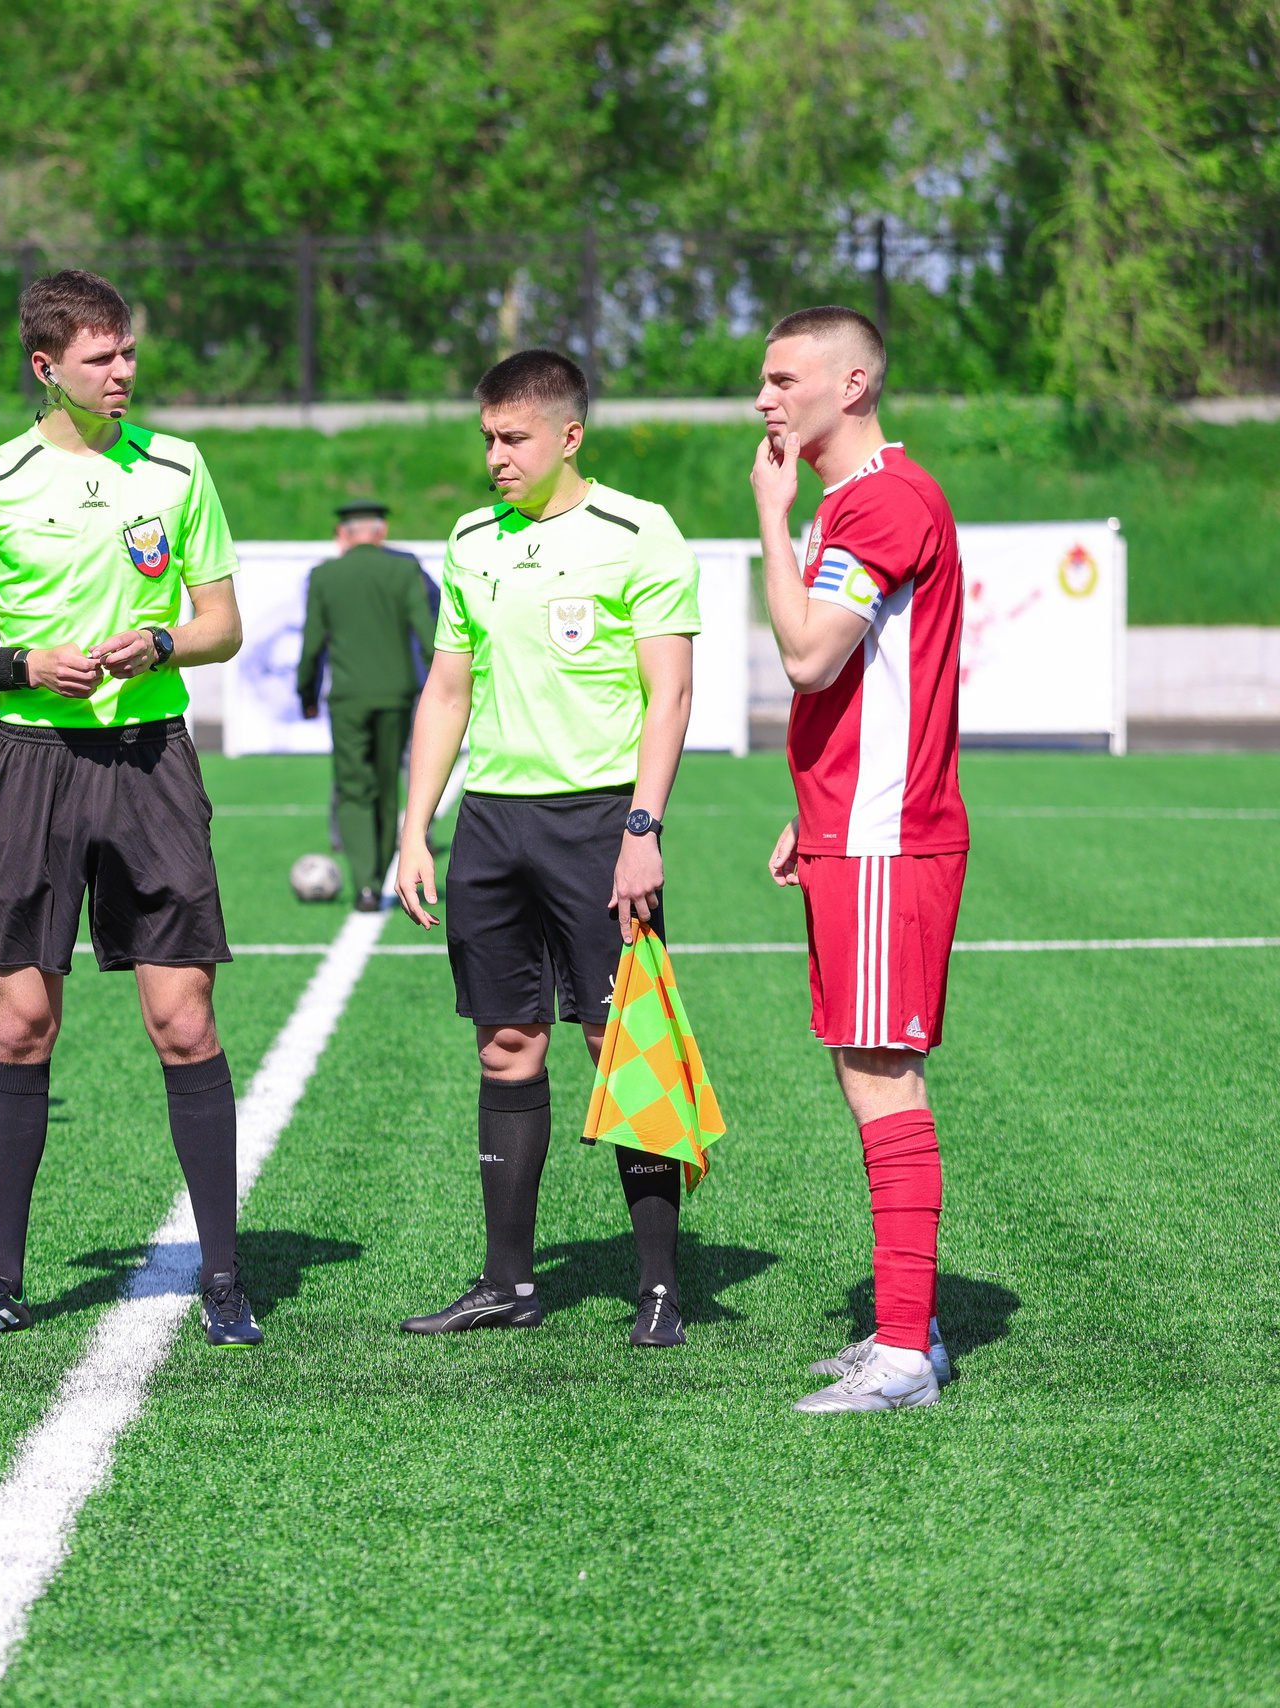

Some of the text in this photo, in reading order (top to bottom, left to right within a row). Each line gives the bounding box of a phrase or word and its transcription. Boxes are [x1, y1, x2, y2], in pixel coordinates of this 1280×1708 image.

[78, 500, 111, 509] JÖGEL
[512, 561, 542, 570] JÖGEL
[478, 1153, 505, 1162] GEL
[626, 1164, 673, 1175] JÖGEL
